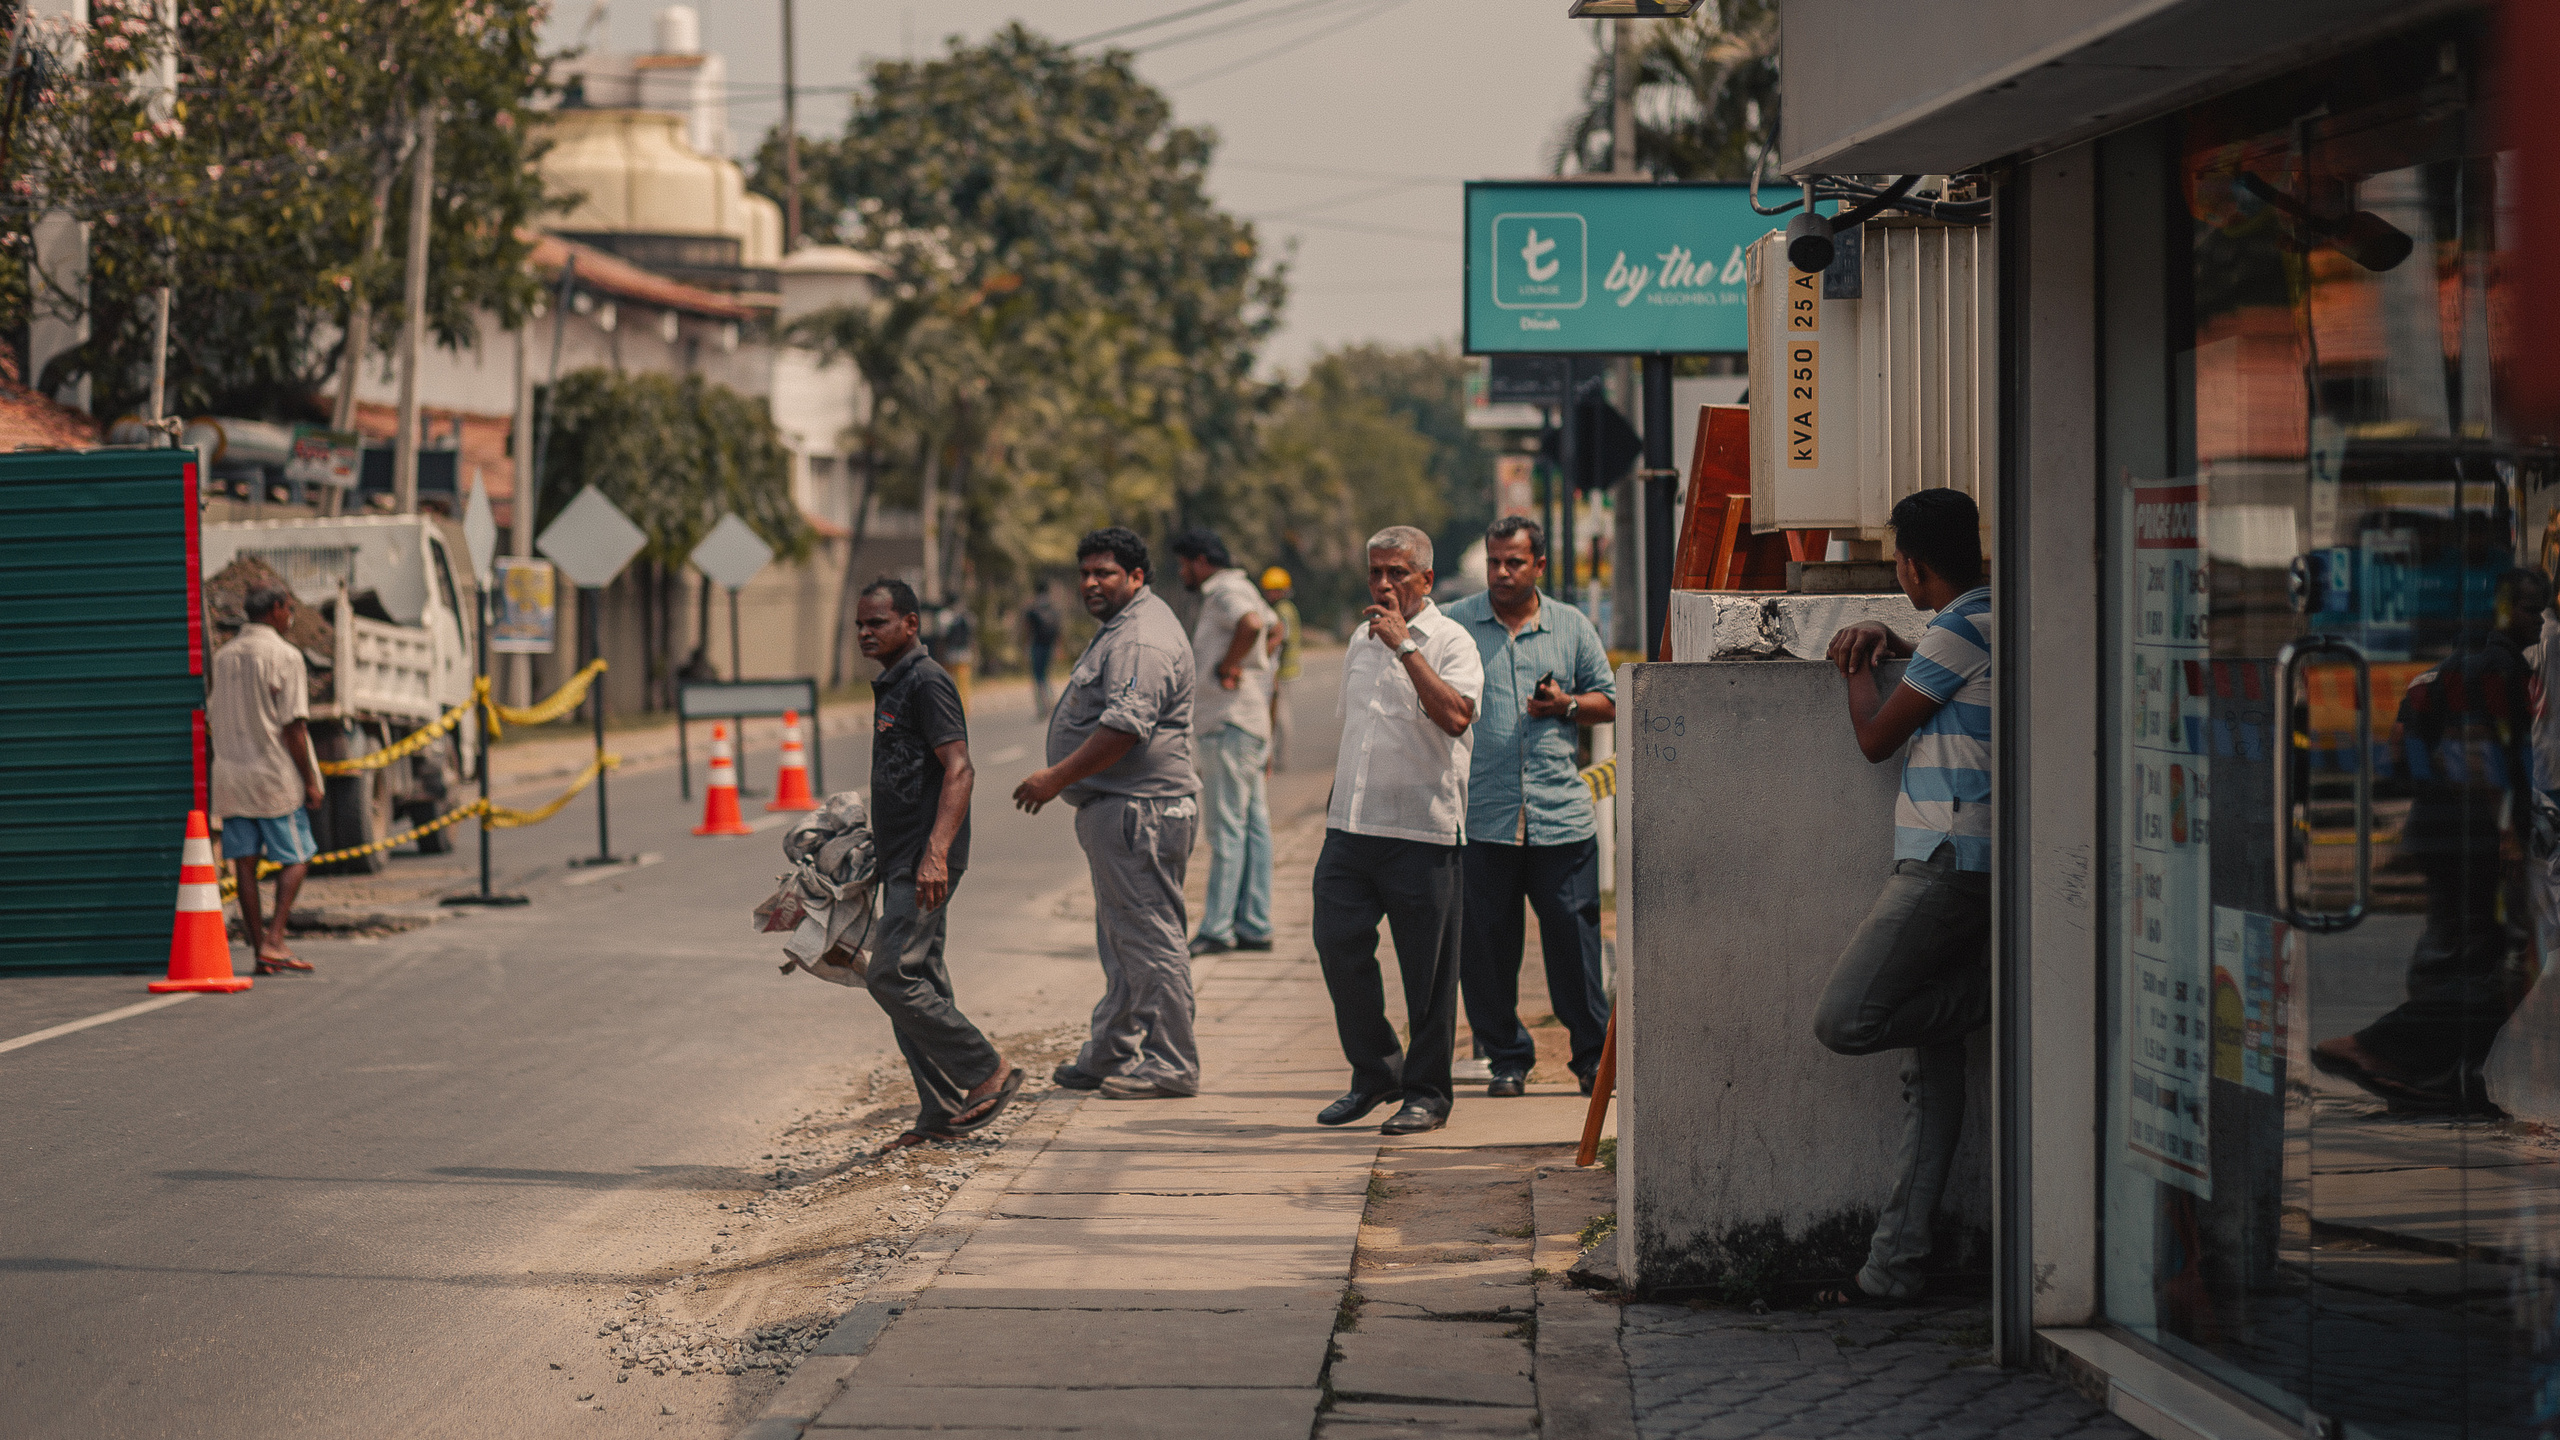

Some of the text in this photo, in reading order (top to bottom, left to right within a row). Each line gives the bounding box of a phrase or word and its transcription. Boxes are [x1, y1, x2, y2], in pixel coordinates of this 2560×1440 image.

[1521, 227, 1560, 282] t
[1603, 250, 1654, 307] by
[1656, 244, 1717, 289] the
[1794, 274, 1813, 328] 25 A
[1794, 348, 1812, 461] kVA 250
[2136, 502, 2170, 539] PRICE
[1644, 708, 1686, 737] 108
[1645, 743, 1677, 762] 110
